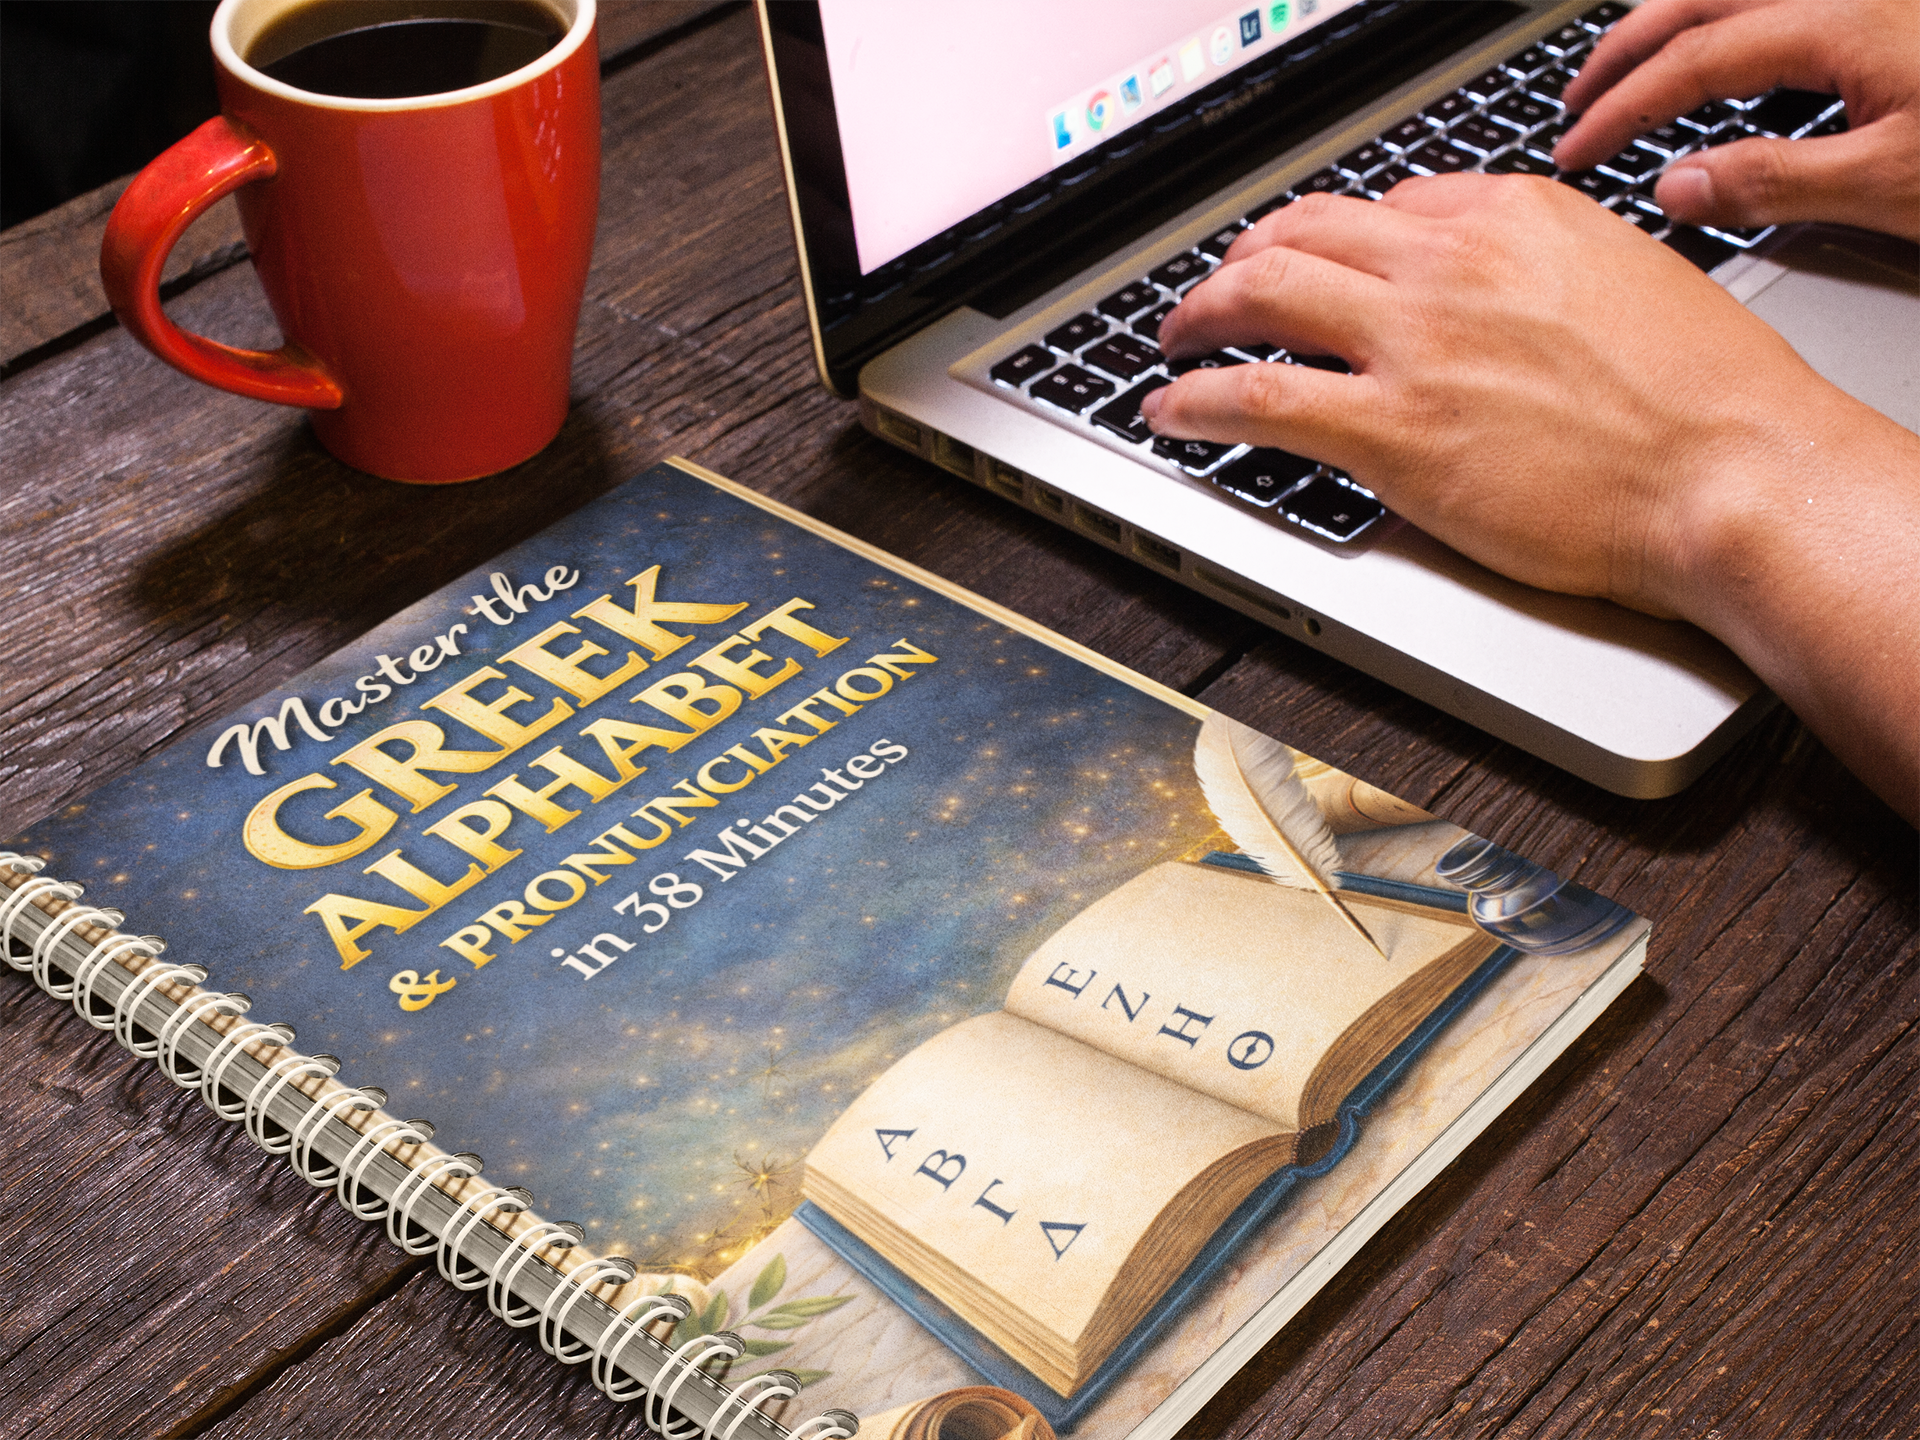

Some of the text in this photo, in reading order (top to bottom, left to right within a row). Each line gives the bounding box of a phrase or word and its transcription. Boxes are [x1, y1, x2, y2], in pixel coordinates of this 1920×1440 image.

[206, 565, 580, 775] Master the
[242, 563, 749, 870] GREEK
[303, 596, 850, 971] ALPHABET
[388, 637, 939, 1012] & PRONUNCIATION
[550, 736, 909, 981] in 38 Minutes
[1226, 1029, 1275, 1071] Θ
[970, 1177, 1019, 1227] Γ
[1038, 1217, 1089, 1262] Δ
